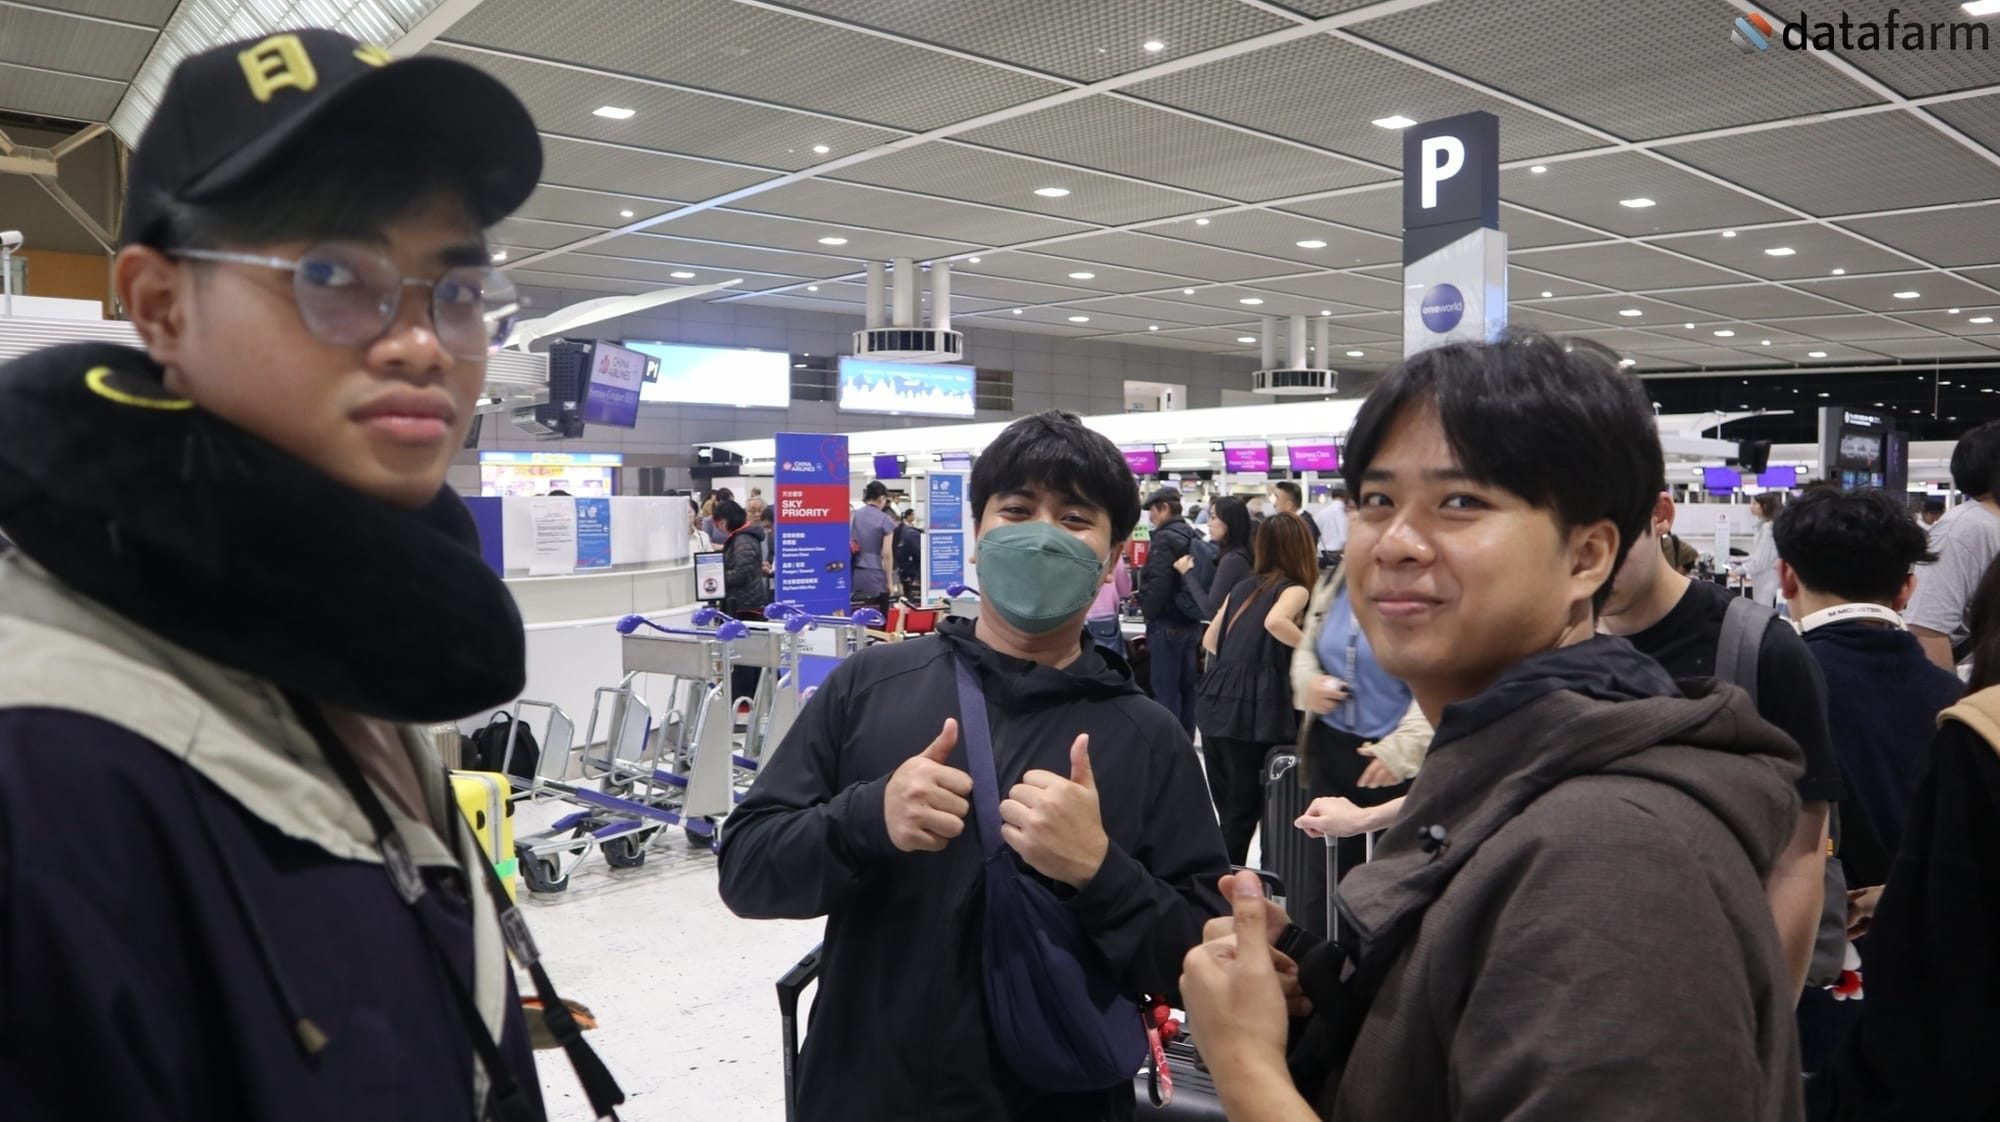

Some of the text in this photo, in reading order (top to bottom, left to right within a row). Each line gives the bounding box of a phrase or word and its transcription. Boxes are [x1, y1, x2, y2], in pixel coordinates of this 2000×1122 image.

[1421, 135, 1466, 209] P
[1422, 301, 1462, 315] oneworld
[612, 356, 629, 369] CHINA
[646, 360, 659, 379] P1
[607, 367, 631, 381] AIRLINES
[782, 500, 803, 508] SKY
[782, 508, 829, 517] PRIORITY
